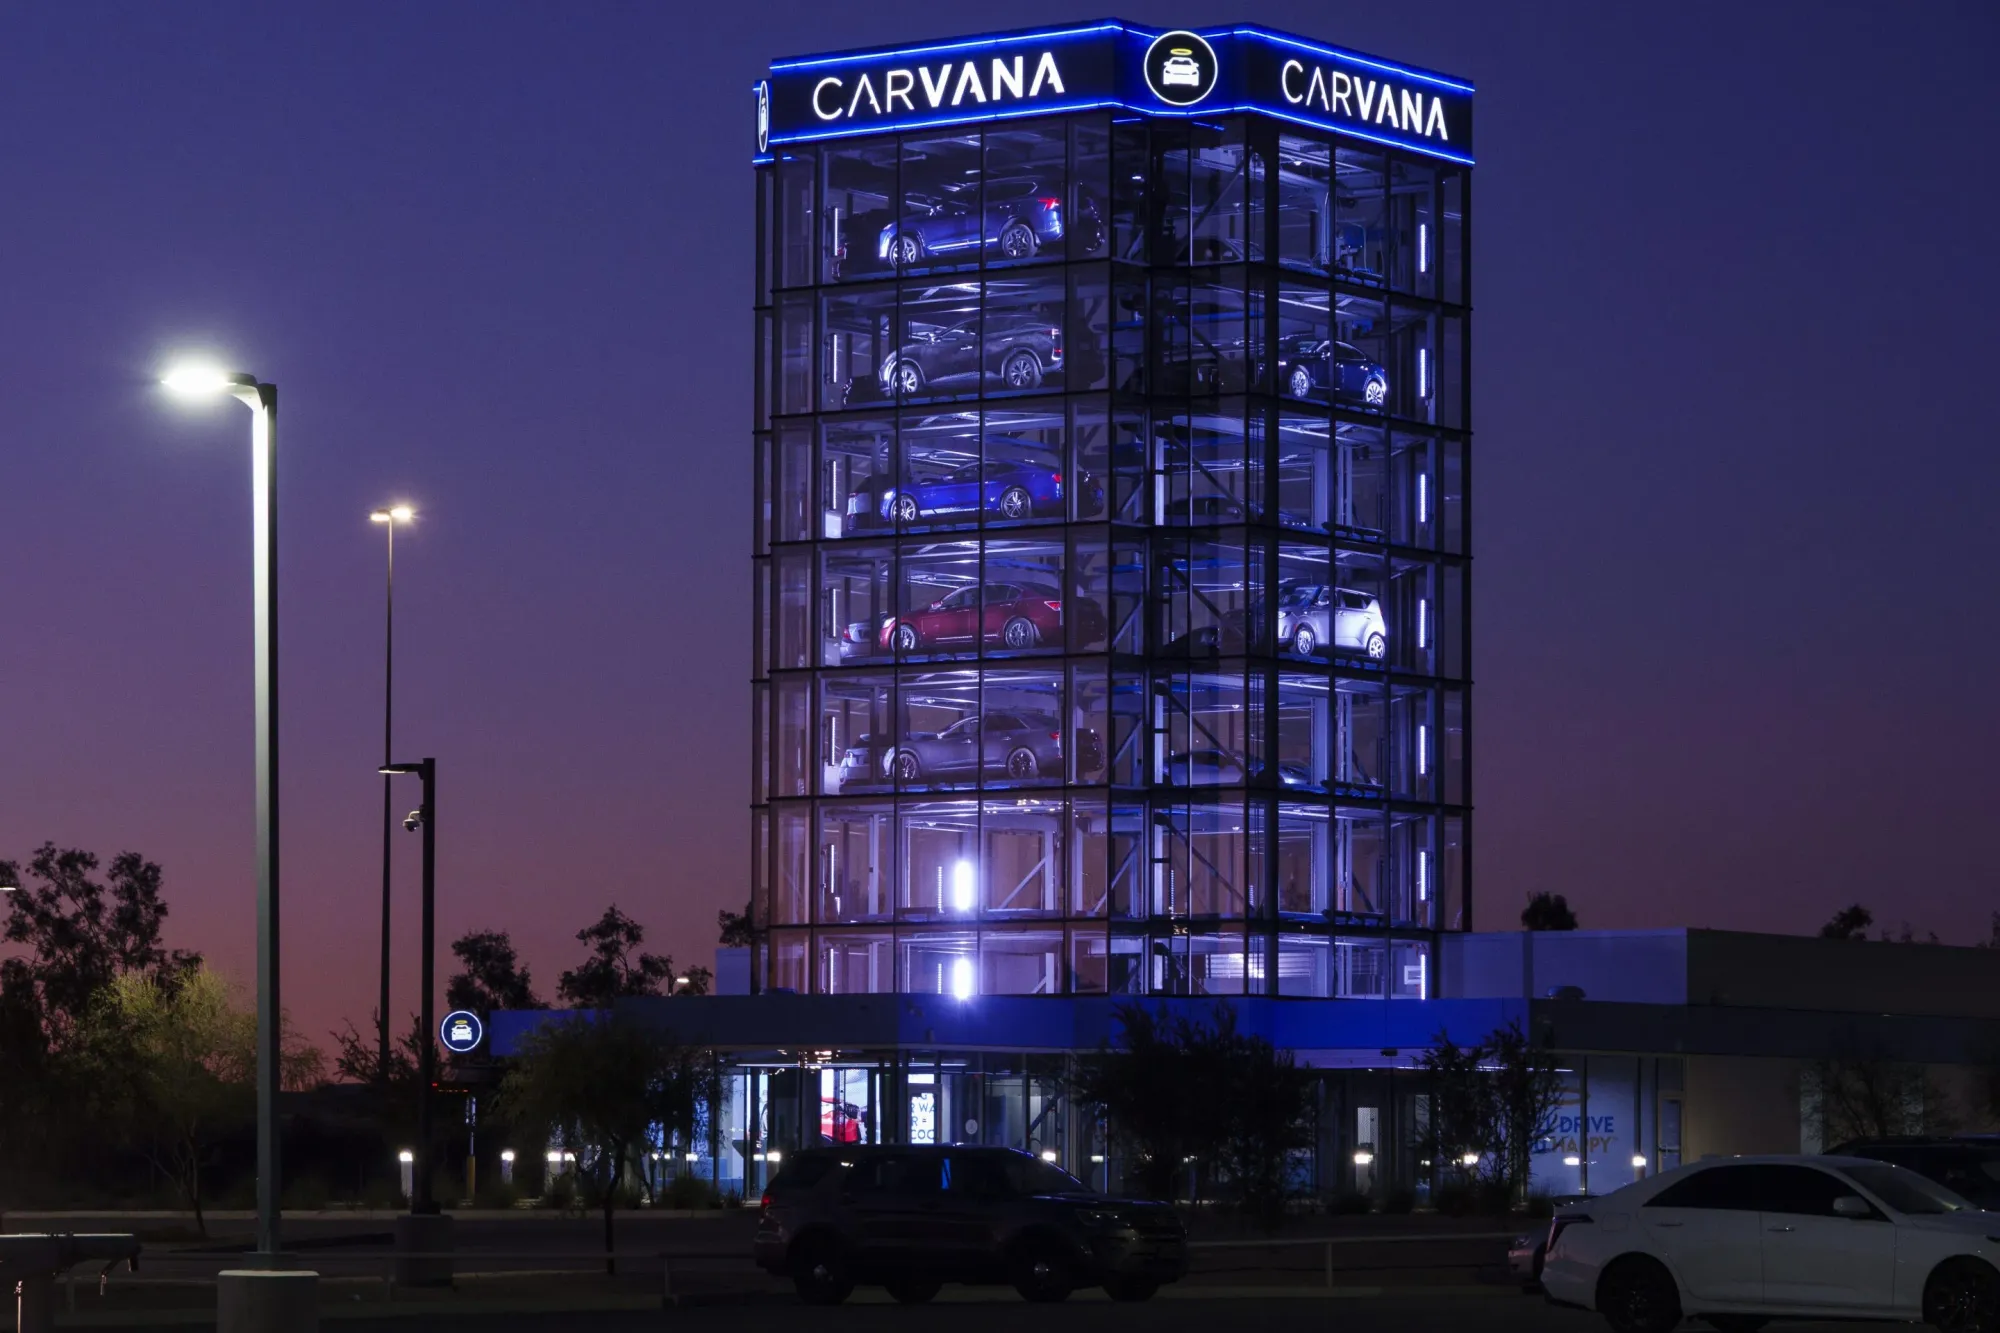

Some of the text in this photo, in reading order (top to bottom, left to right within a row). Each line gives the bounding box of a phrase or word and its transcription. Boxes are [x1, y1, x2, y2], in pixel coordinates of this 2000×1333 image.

[812, 52, 1066, 120] CARVANA
[1281, 59, 1449, 141] CARVANA
[1553, 1137, 1610, 1153] HAPY
